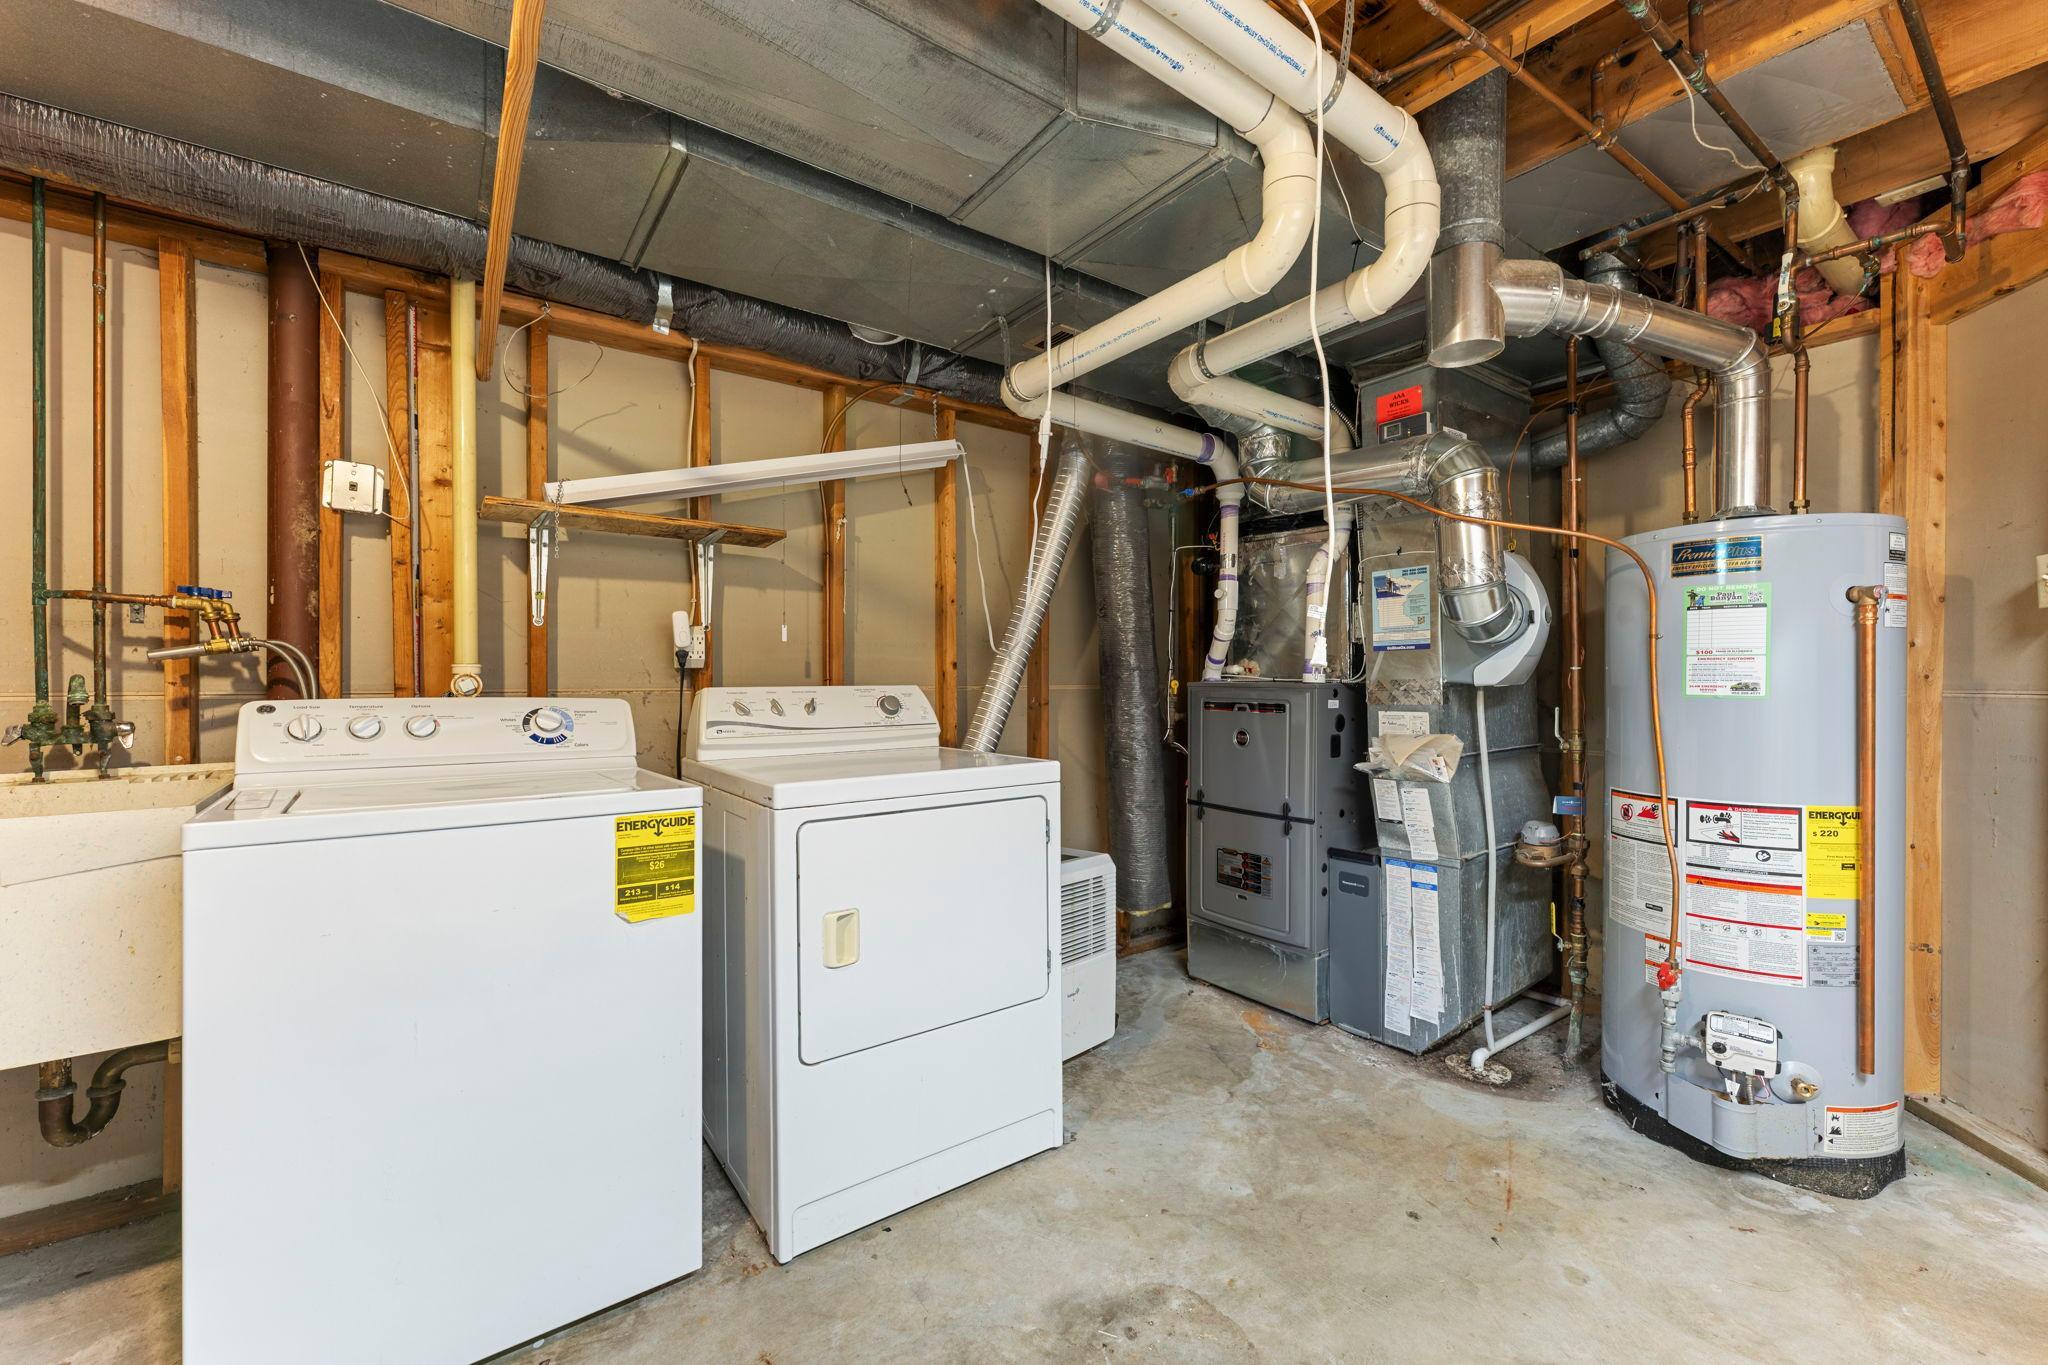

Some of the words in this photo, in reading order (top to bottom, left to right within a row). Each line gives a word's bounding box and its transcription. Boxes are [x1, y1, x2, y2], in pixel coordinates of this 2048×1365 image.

[1808, 811, 1861, 822] ENERGYGUI
[616, 816, 695, 834] ENERGYGUIDE
[624, 888, 641, 897] 213
